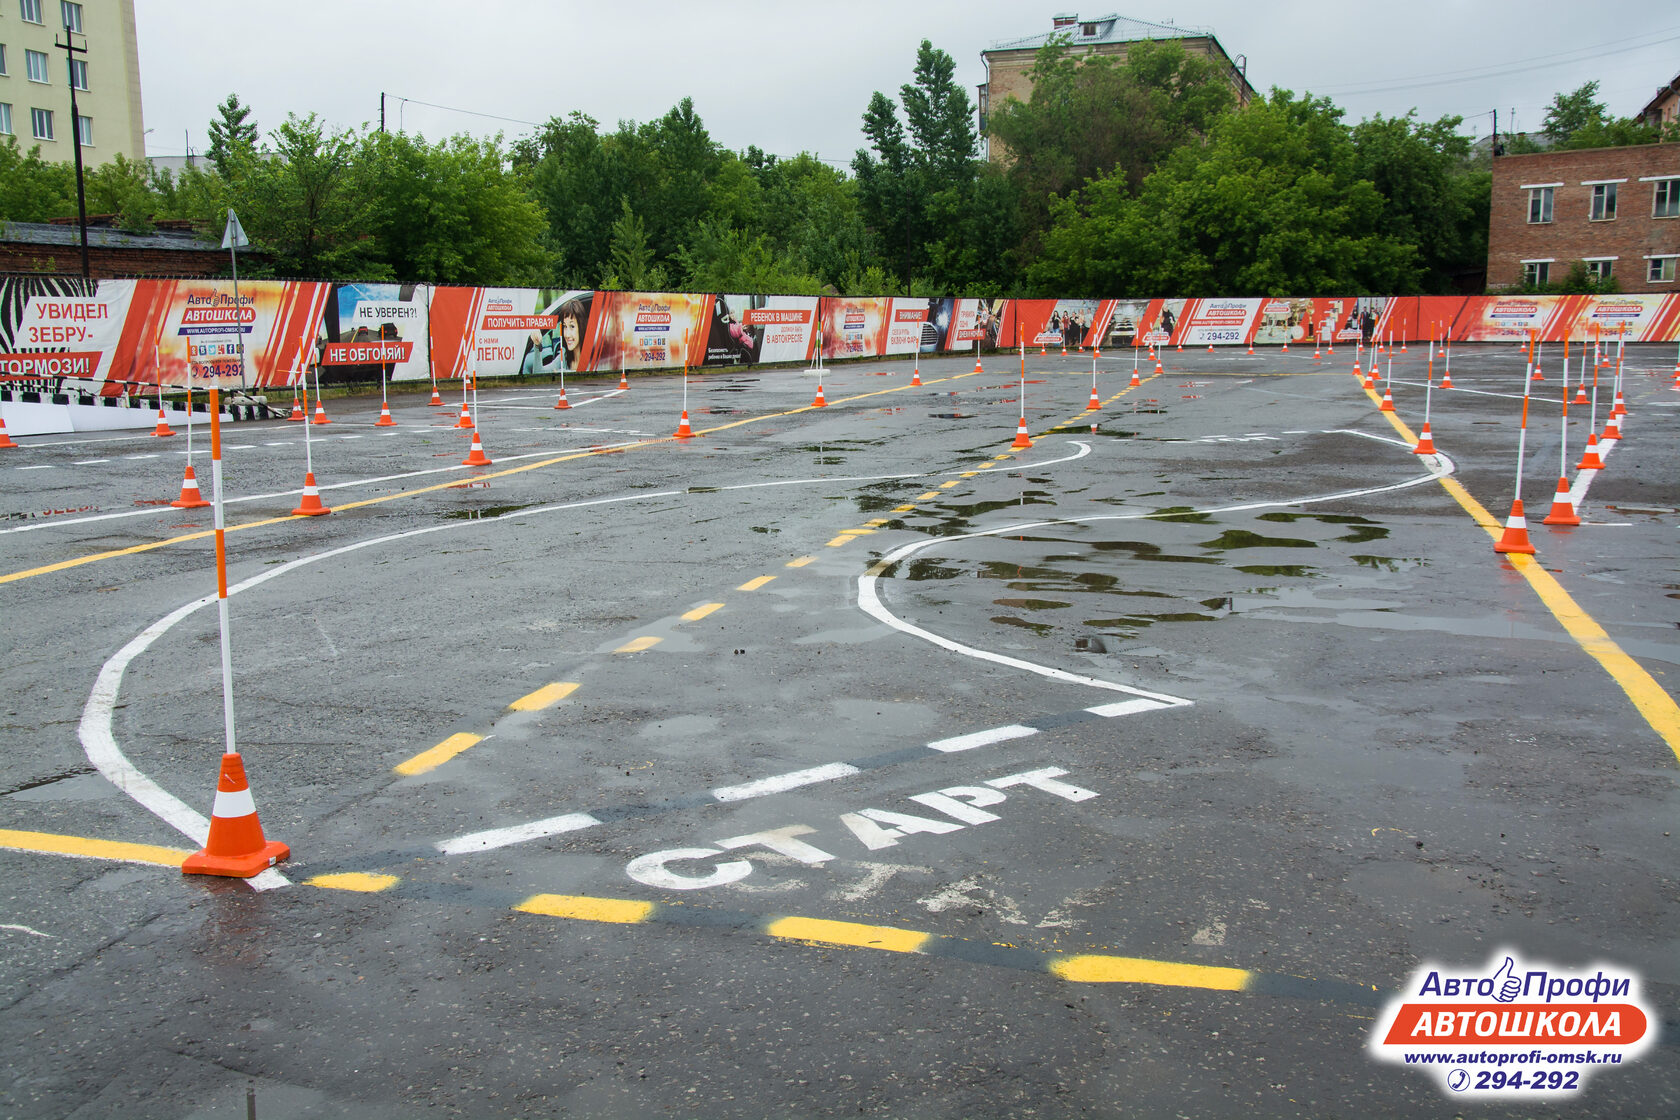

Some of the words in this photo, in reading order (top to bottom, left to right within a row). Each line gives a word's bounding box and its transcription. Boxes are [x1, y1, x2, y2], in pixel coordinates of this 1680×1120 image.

[187, 294, 212, 304] Авто
[36, 303, 108, 322] УВИДЕЛ
[185, 310, 252, 322] АВТОШКОЛА
[360, 307, 373, 318] НЕ
[376, 307, 417, 318] УВЕРЕН?!
[751, 313, 775, 321] РЕБЕНОК
[776, 313, 780, 321] В
[781, 313, 802, 321] МАШИНЕ
[488, 318, 525, 328] ПОЛУЧИТЬ
[526, 318, 554, 327] ПРАВА?!
[28, 327, 94, 343] ЗЕБРУ-
[767, 335, 770, 344] В
[1207, 332, 1239, 340] 294-292
[330, 348, 346, 362] НЕ
[349, 345, 405, 361] ОБГОНЯЙ!
[477, 347, 515, 361] ЛЕГКО!
[644, 352, 665, 361] 294-292
[626, 766, 1100, 890] СТАРТ
